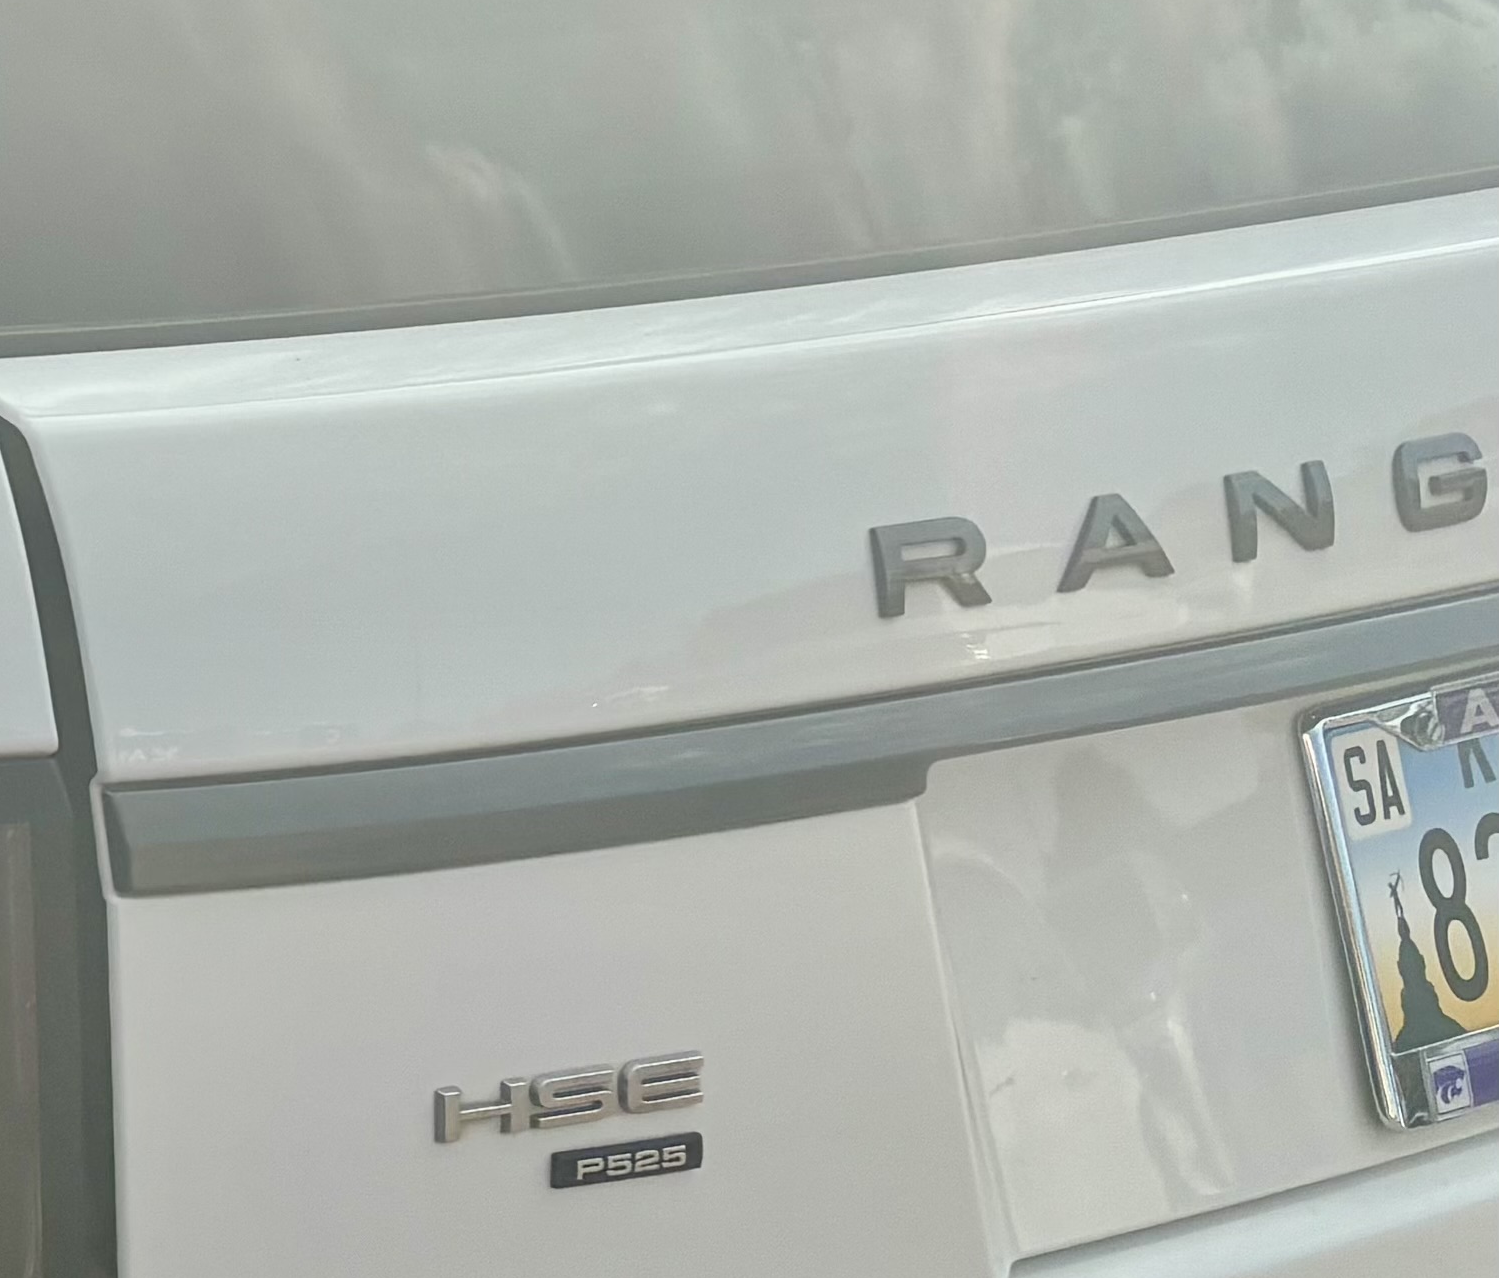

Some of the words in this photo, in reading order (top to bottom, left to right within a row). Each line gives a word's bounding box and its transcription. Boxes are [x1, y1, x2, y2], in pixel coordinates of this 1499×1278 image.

[869, 431, 1489, 619] RANG
[1343, 738, 1406, 827] SA
[433, 1049, 705, 1144] HSE
[576, 1143, 687, 1181] P525
